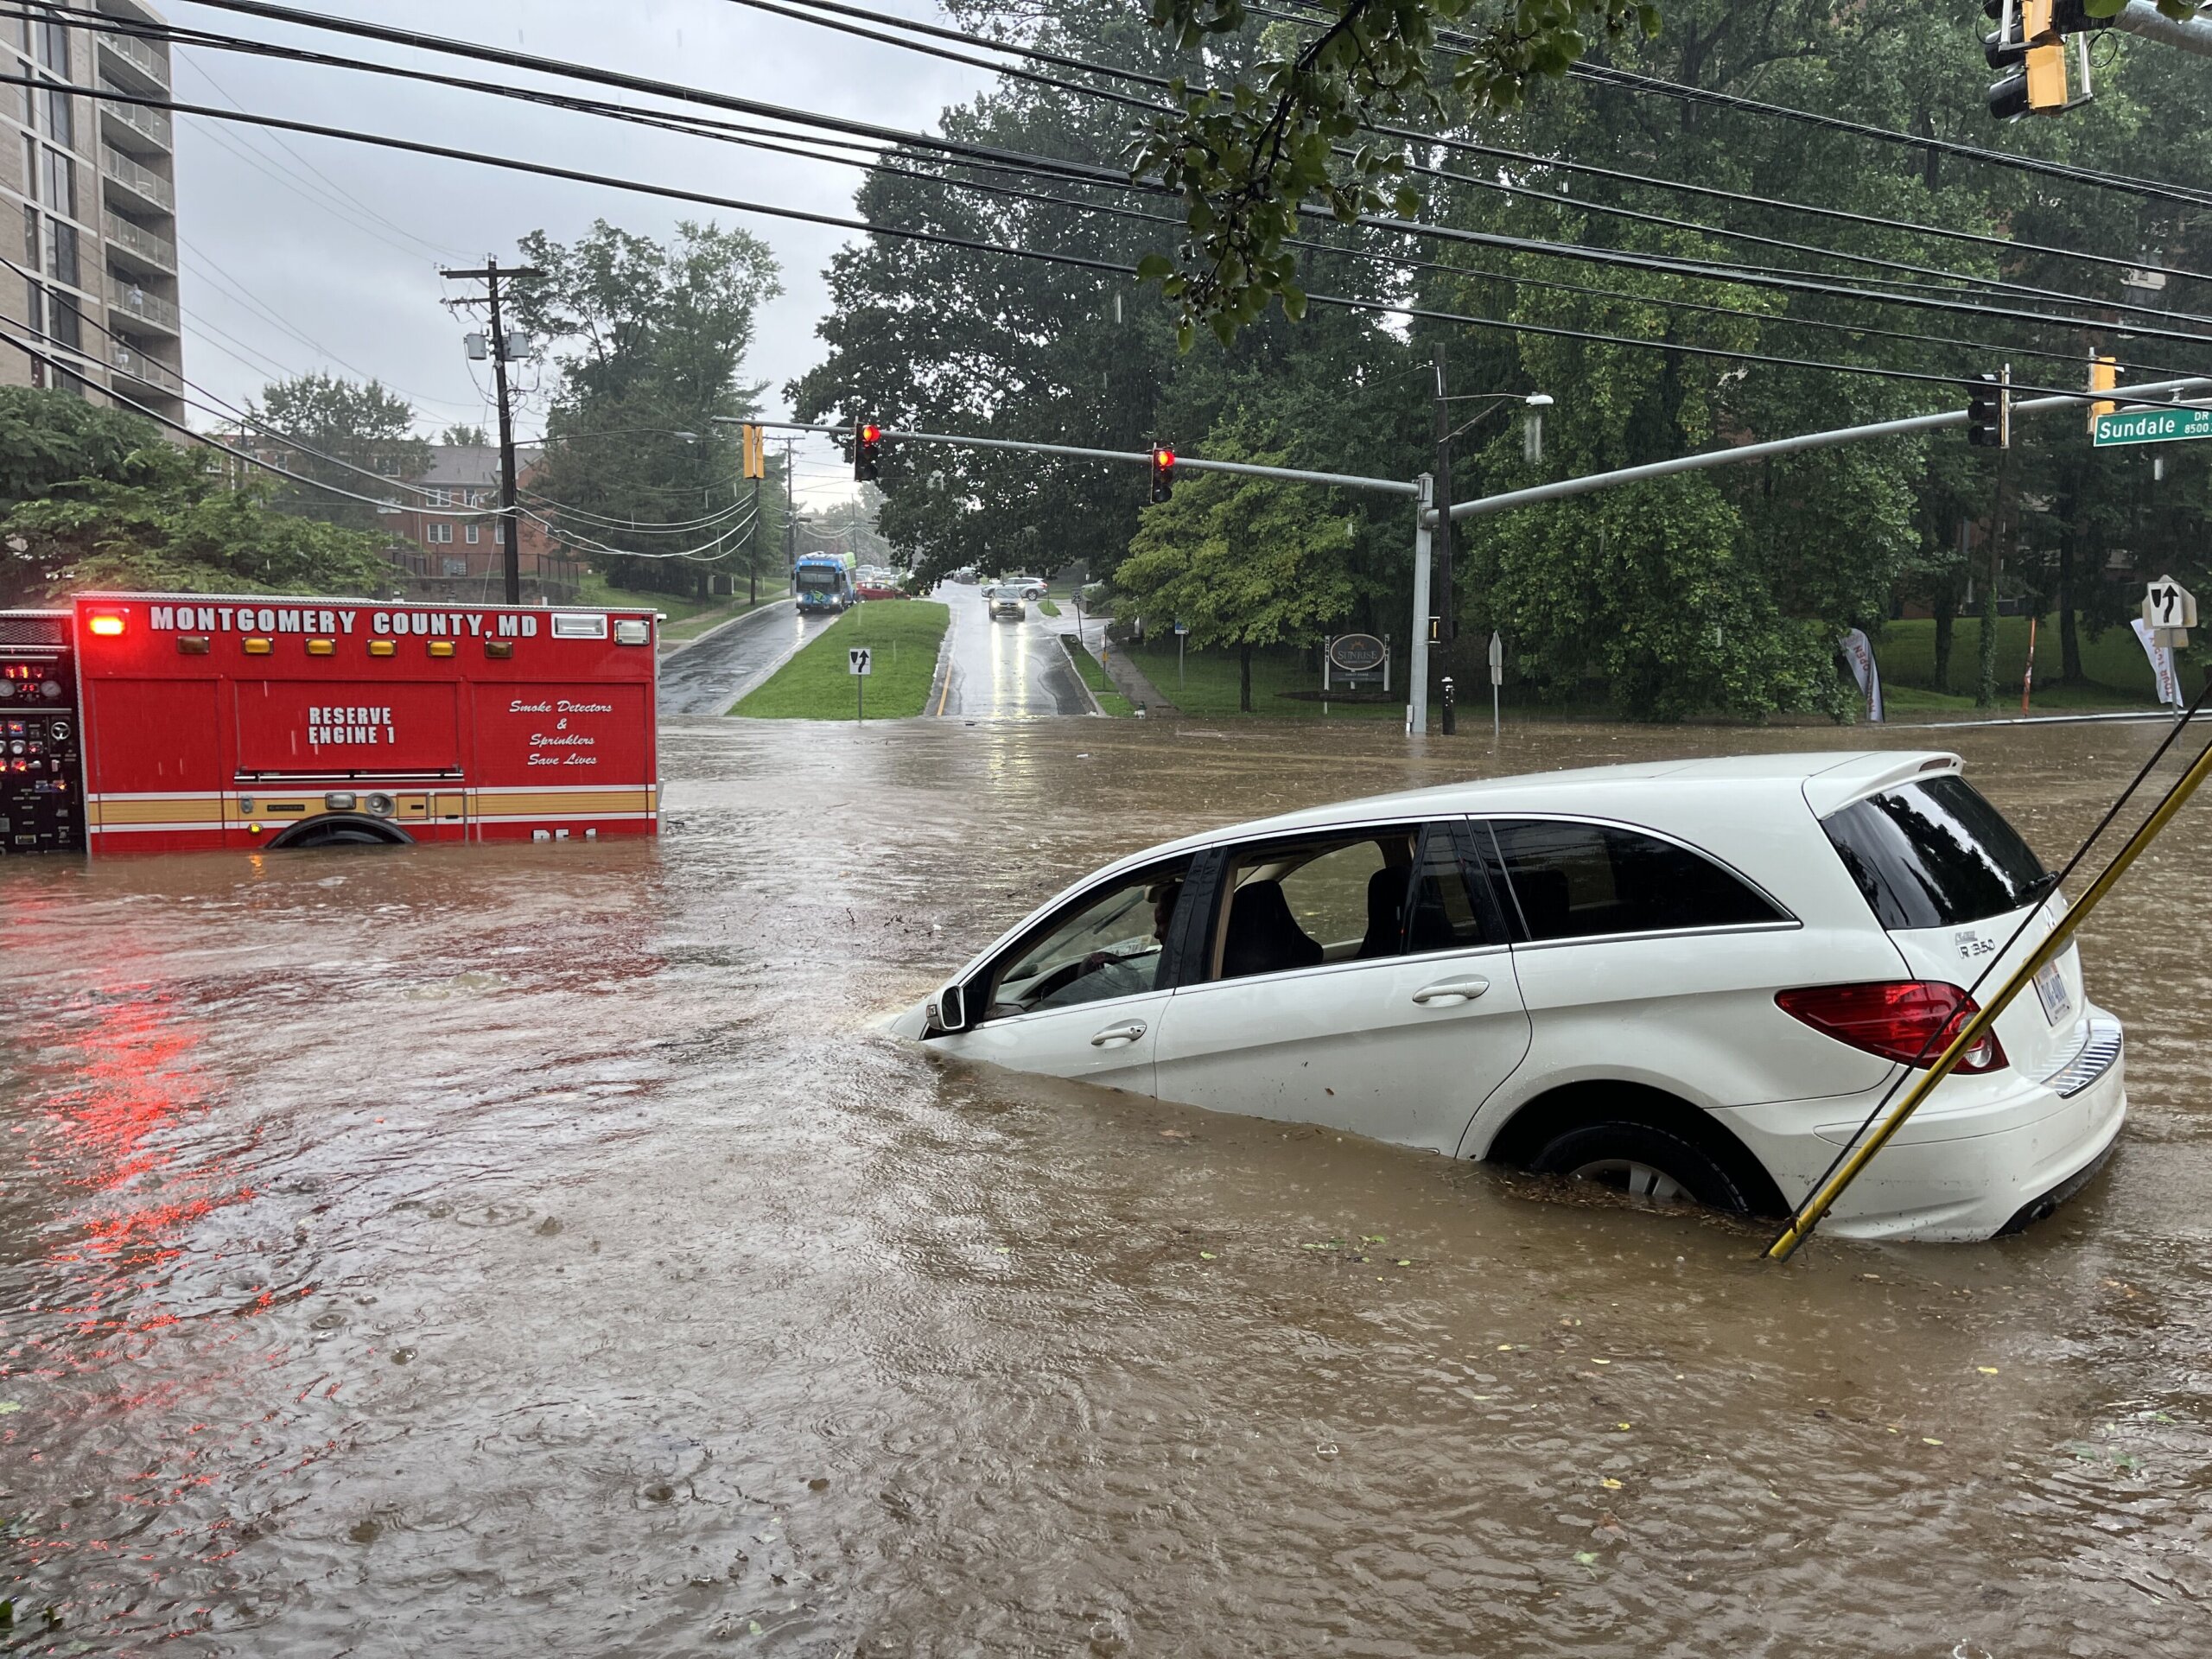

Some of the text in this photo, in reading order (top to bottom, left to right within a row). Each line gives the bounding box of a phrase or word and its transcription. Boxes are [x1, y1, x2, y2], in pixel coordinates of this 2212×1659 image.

[2099, 411, 2209, 439] Sundale DR
[2184, 423, 2209, 434] 8500
[150, 607, 356, 633] MONTGOMERY
[1338, 650, 1377, 660] SUNRISE
[1853, 645, 1871, 671] OPEN
[2160, 670, 2173, 697] TOUR
[509, 700, 613, 712] Smoke Detectors
[309, 707, 391, 724] RESERVE
[556, 718, 567, 729] &
[308, 726, 395, 744] ENGINE 1
[529, 734, 594, 748] Sprinklers
[527, 753, 597, 766] Save Lives
[1958, 946, 1970, 959] R
[1970, 938, 1995, 956] 350
